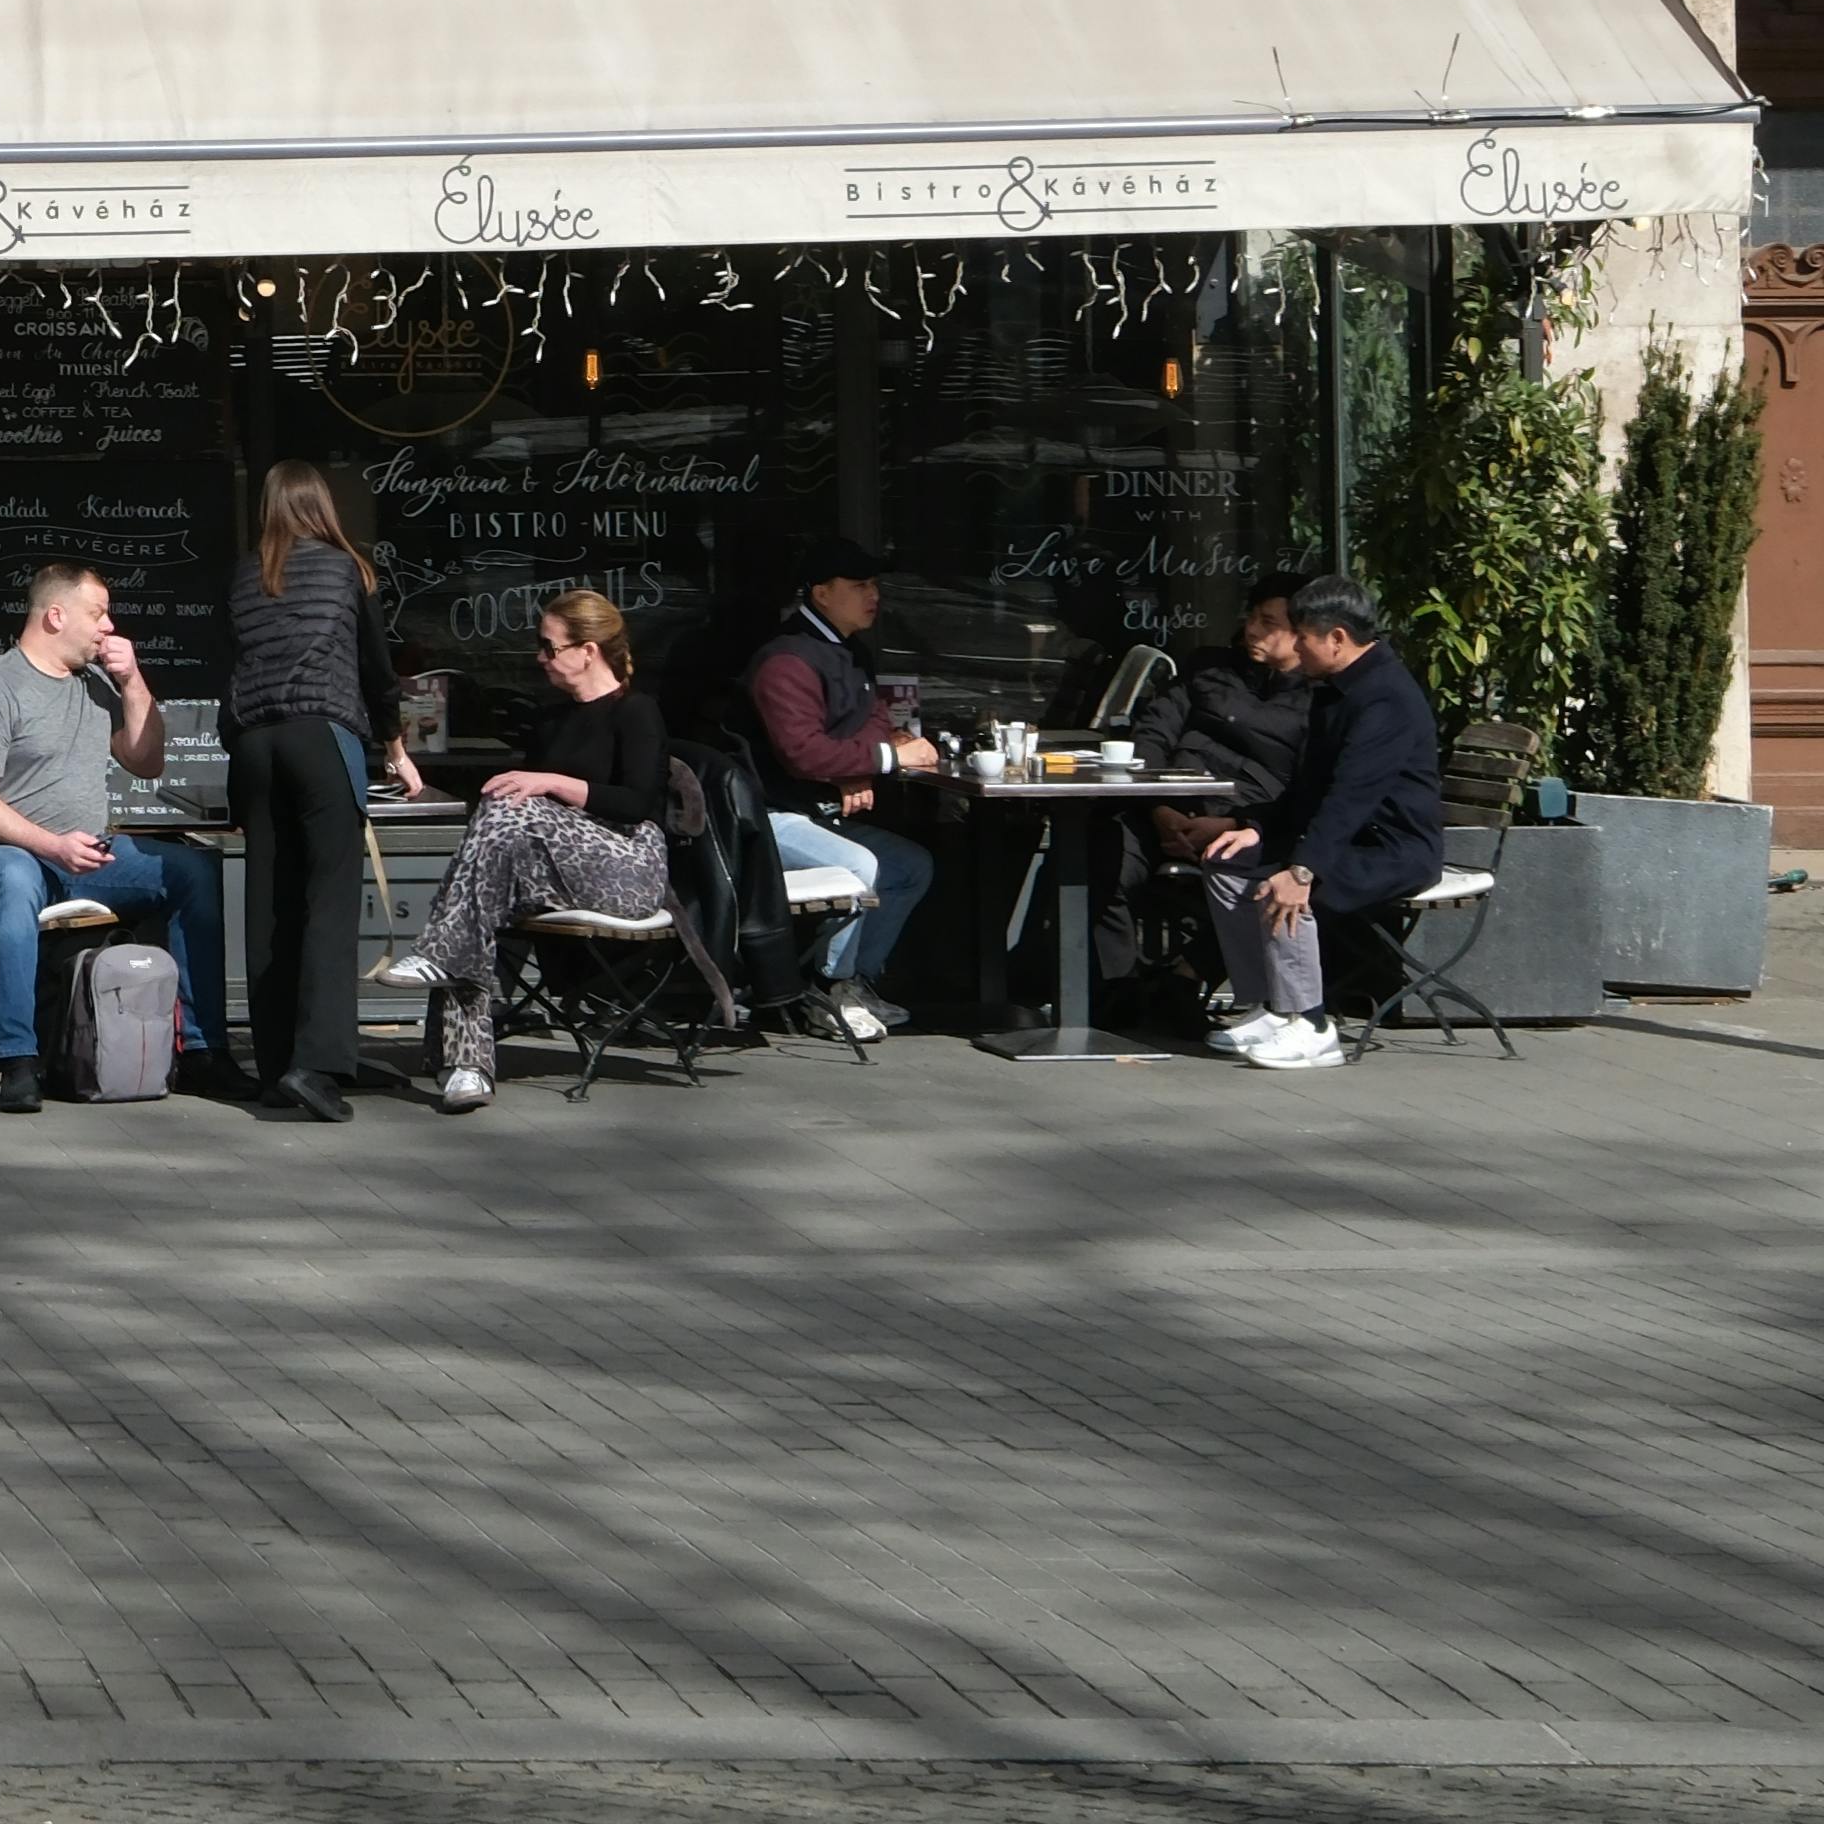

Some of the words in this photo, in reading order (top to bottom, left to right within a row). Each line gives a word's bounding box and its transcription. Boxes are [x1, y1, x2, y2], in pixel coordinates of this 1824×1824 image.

[846, 182, 992, 202] Bistro
[997, 156, 1053, 232] &
[1045, 174, 1217, 196] Kávéház
[17, 200, 191, 220] Kávéház
[23, 382, 55, 404] Eggs
[90, 380, 152, 399] French
[153, 381, 200, 399] Toast
[22, 407, 76, 418] COFFEE
[82, 400, 94, 418] &
[101, 407, 133, 418] TEA
[96, 425, 162, 450] Juices
[362, 445, 512, 518] Hungarian
[553, 447, 760, 495] International
[1104, 470, 1241, 498] DINNER
[77, 494, 193, 519] Kedvencek
[1136, 510, 1202, 522] WITH
[449, 510, 568, 540] BISTRO
[25, 529, 167, 556] HÉTVÉGÉRE
[1000, 531, 1104, 578] Live
[1116, 535, 1254, 578] Music
[105, 567, 148, 588] cials
[449, 560, 665, 642] COCKTILS
